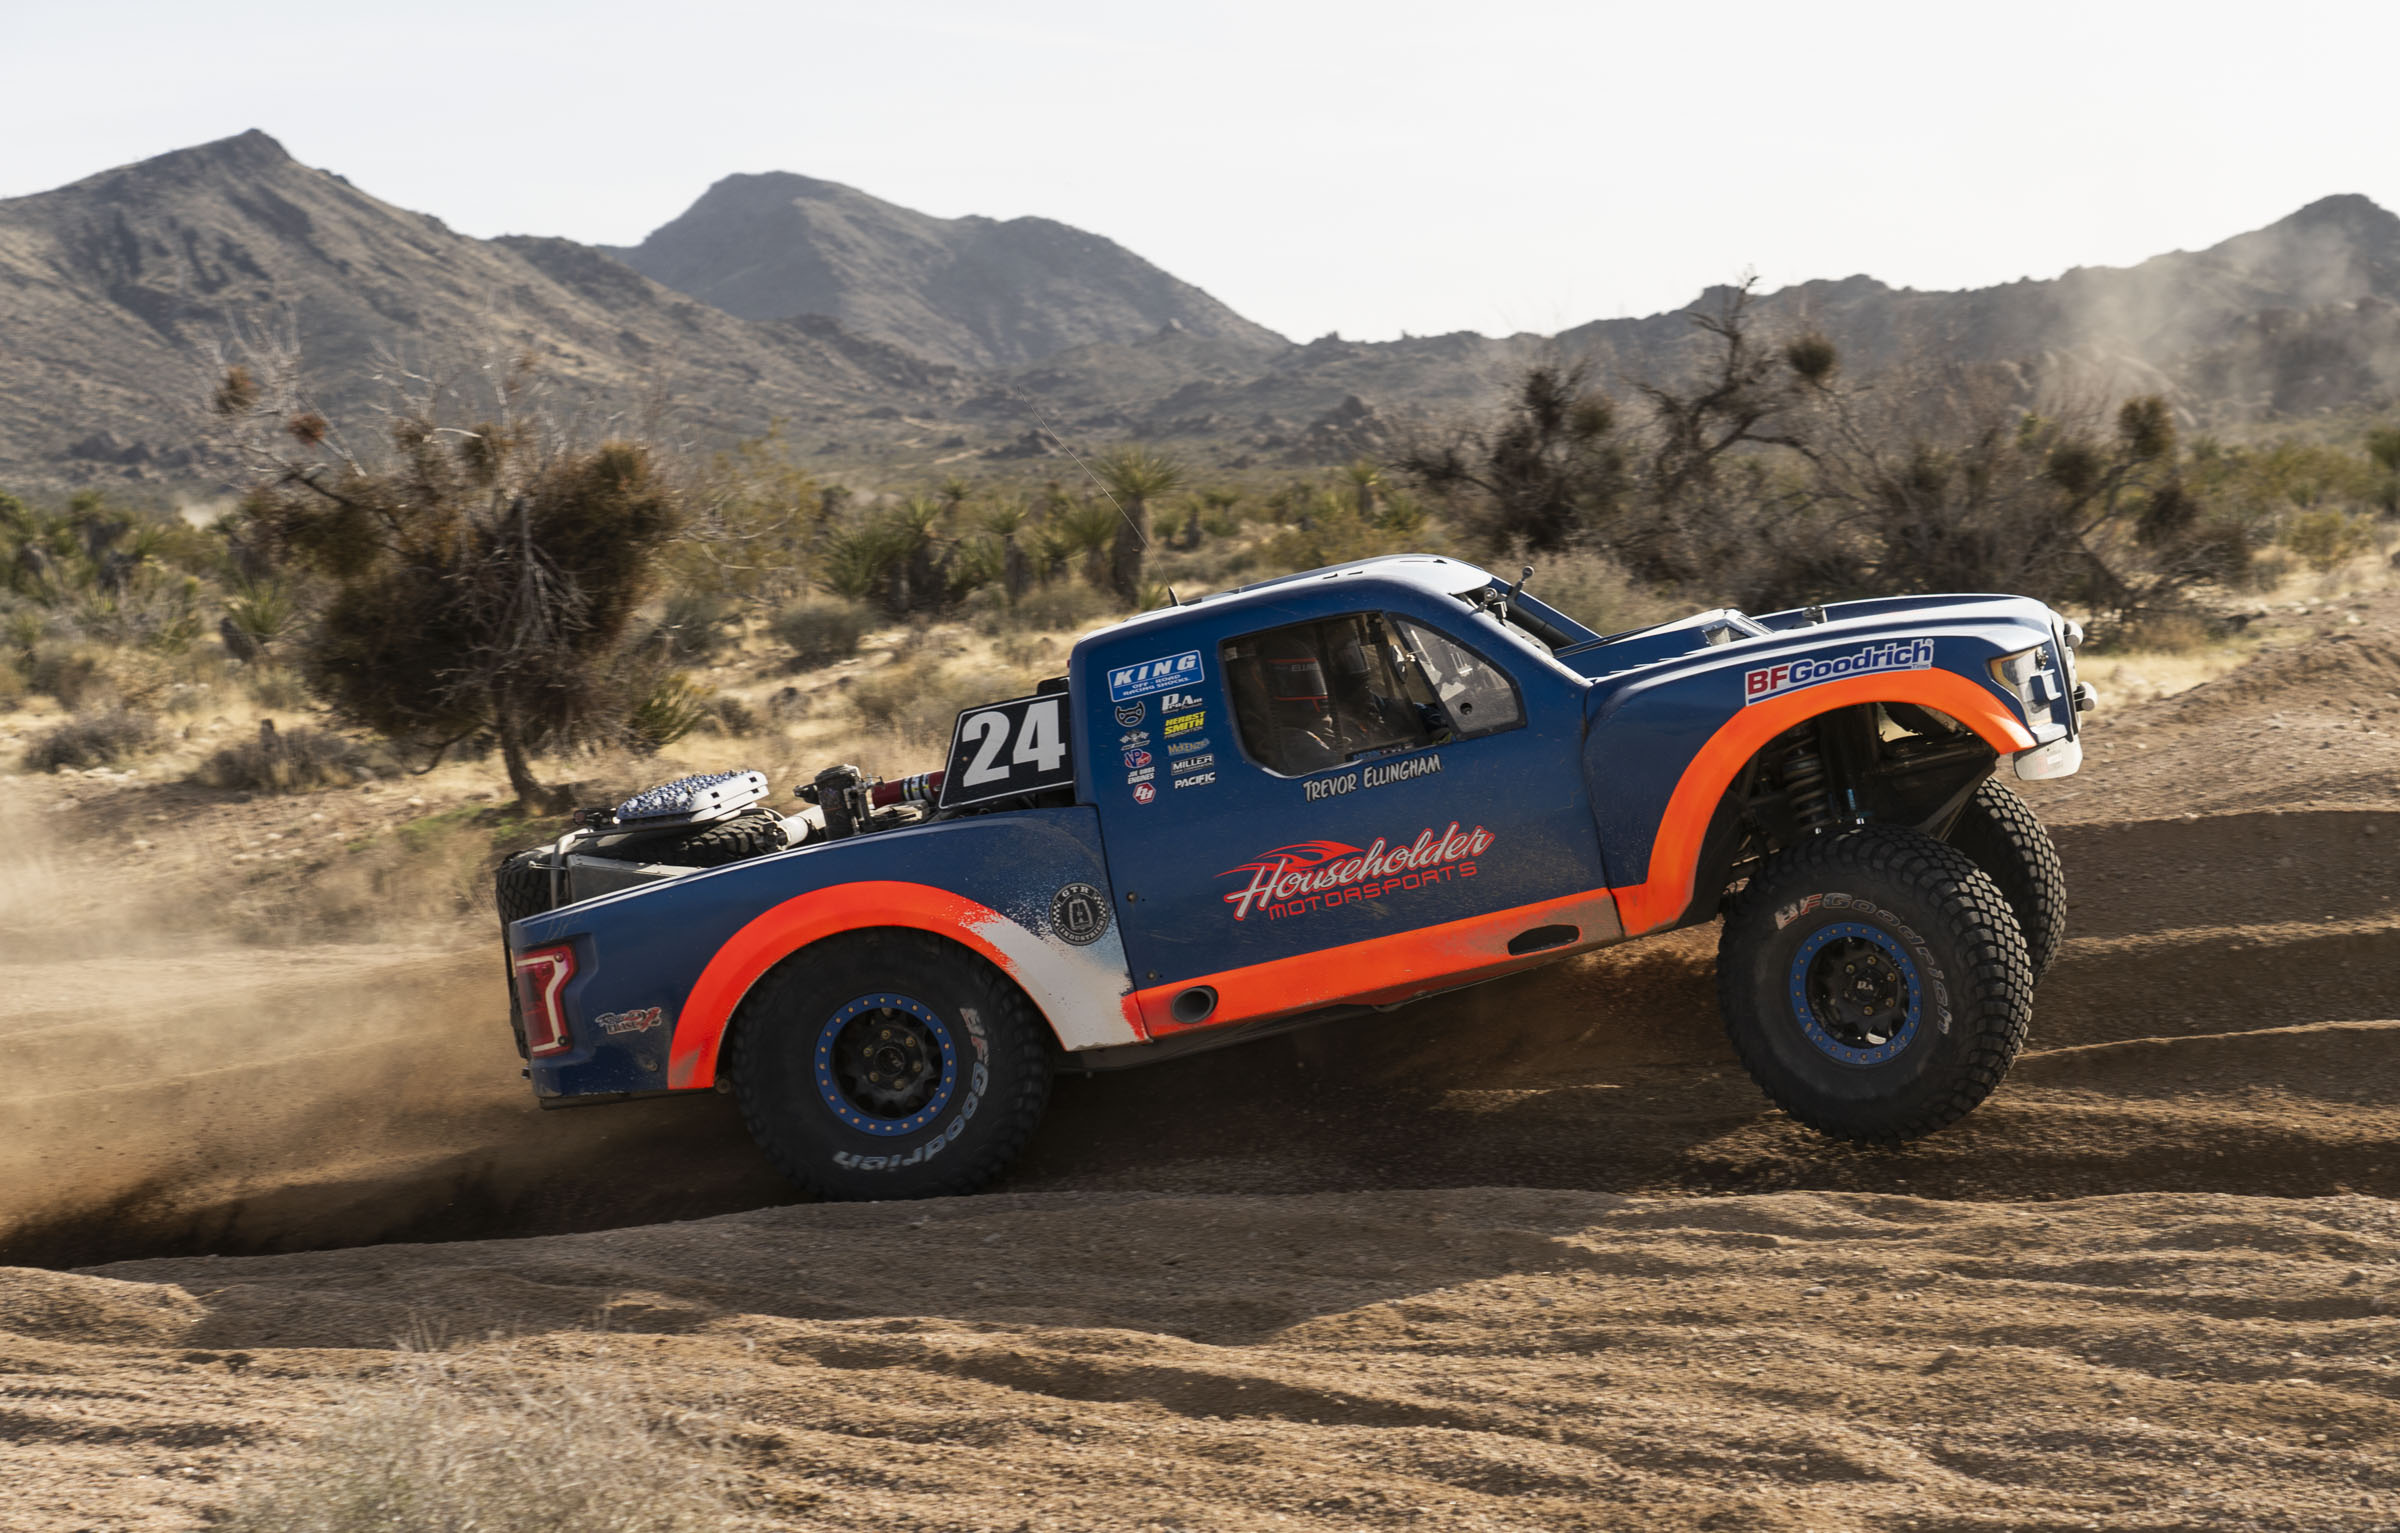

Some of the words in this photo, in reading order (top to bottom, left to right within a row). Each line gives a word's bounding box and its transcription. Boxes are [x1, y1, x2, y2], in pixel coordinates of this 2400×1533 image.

[1113, 654, 1197, 687] KING
[1747, 640, 1932, 696] BFGoodrich
[1122, 684, 1156, 696] RACING
[1156, 676, 1189, 688] SHOCKS
[1131, 681, 1149, 689] OFF
[1163, 718, 1205, 735] SMITH
[1165, 710, 1207, 727] HERBST
[961, 699, 1066, 788] 24
[1125, 749, 1143, 767] VP
[1172, 755, 1213, 770] MILLER
[1174, 771, 1216, 789] PACIFIC
[1303, 772, 1357, 801] TREVOR
[1363, 754, 1442, 788] ELLINGHAM
[1224, 821, 1495, 921] Householder
[1061, 886, 1090, 898] GTR
[1268, 861, 1478, 921] MOTORSPORTS
[1060, 920, 1106, 942] INDUSTRIES
